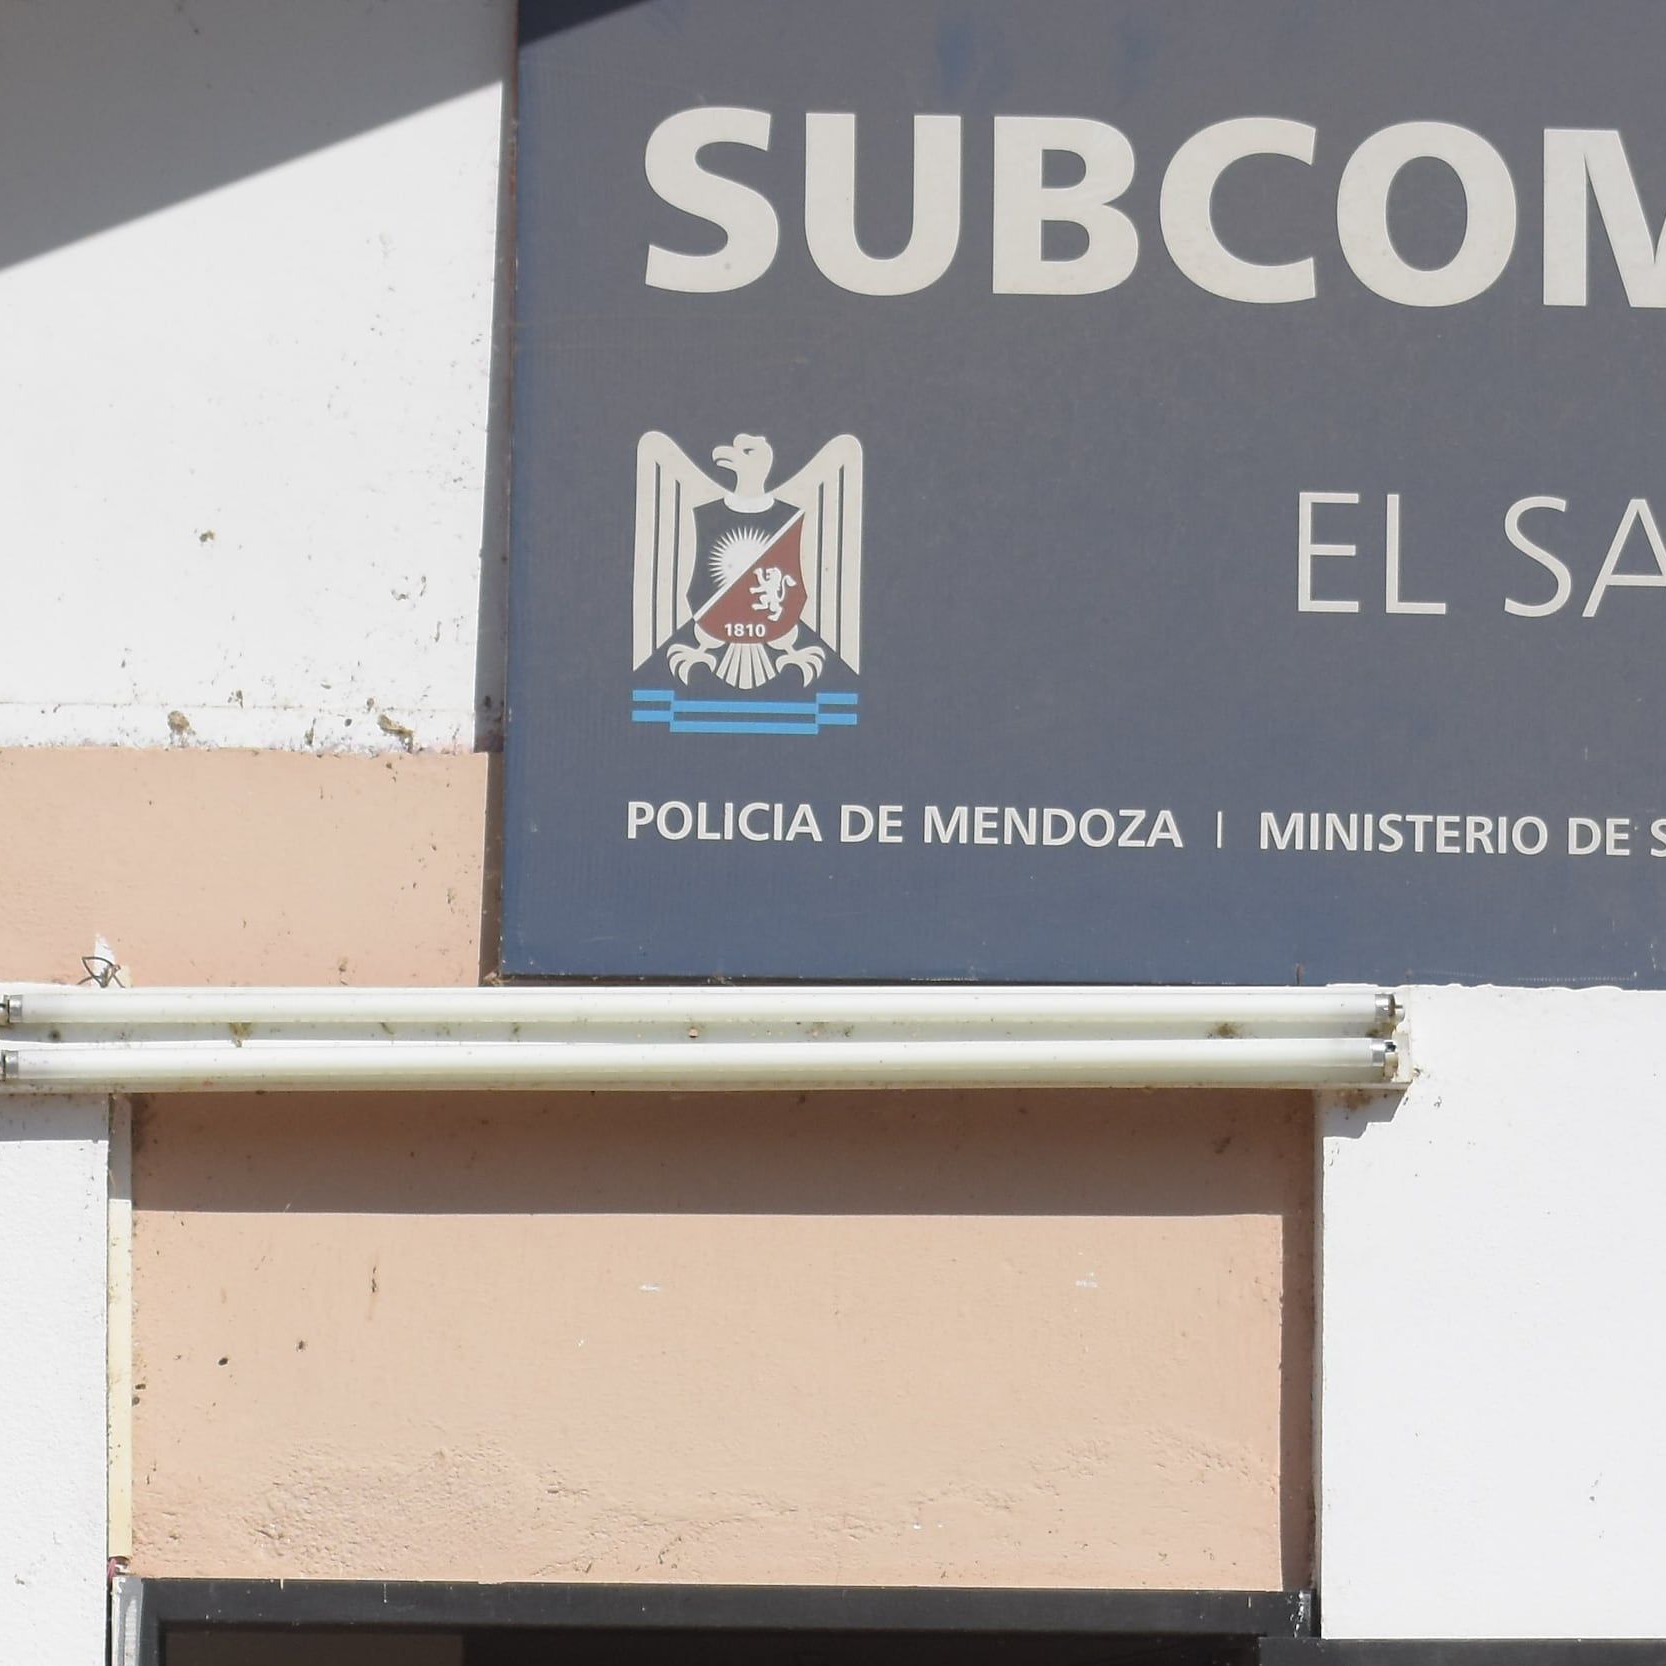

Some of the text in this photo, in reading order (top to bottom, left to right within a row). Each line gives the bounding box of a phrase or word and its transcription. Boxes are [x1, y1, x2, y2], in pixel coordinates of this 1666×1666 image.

[1298, 491, 1447, 615] EL
[723, 623, 766, 638] 1810
[626, 801, 823, 842] POLICIA
[839, 805, 904, 843] DE
[923, 805, 1183, 849] MENDOZA
[1259, 811, 1550, 855] MINISTERIO
[1566, 817, 1631, 857] DE
